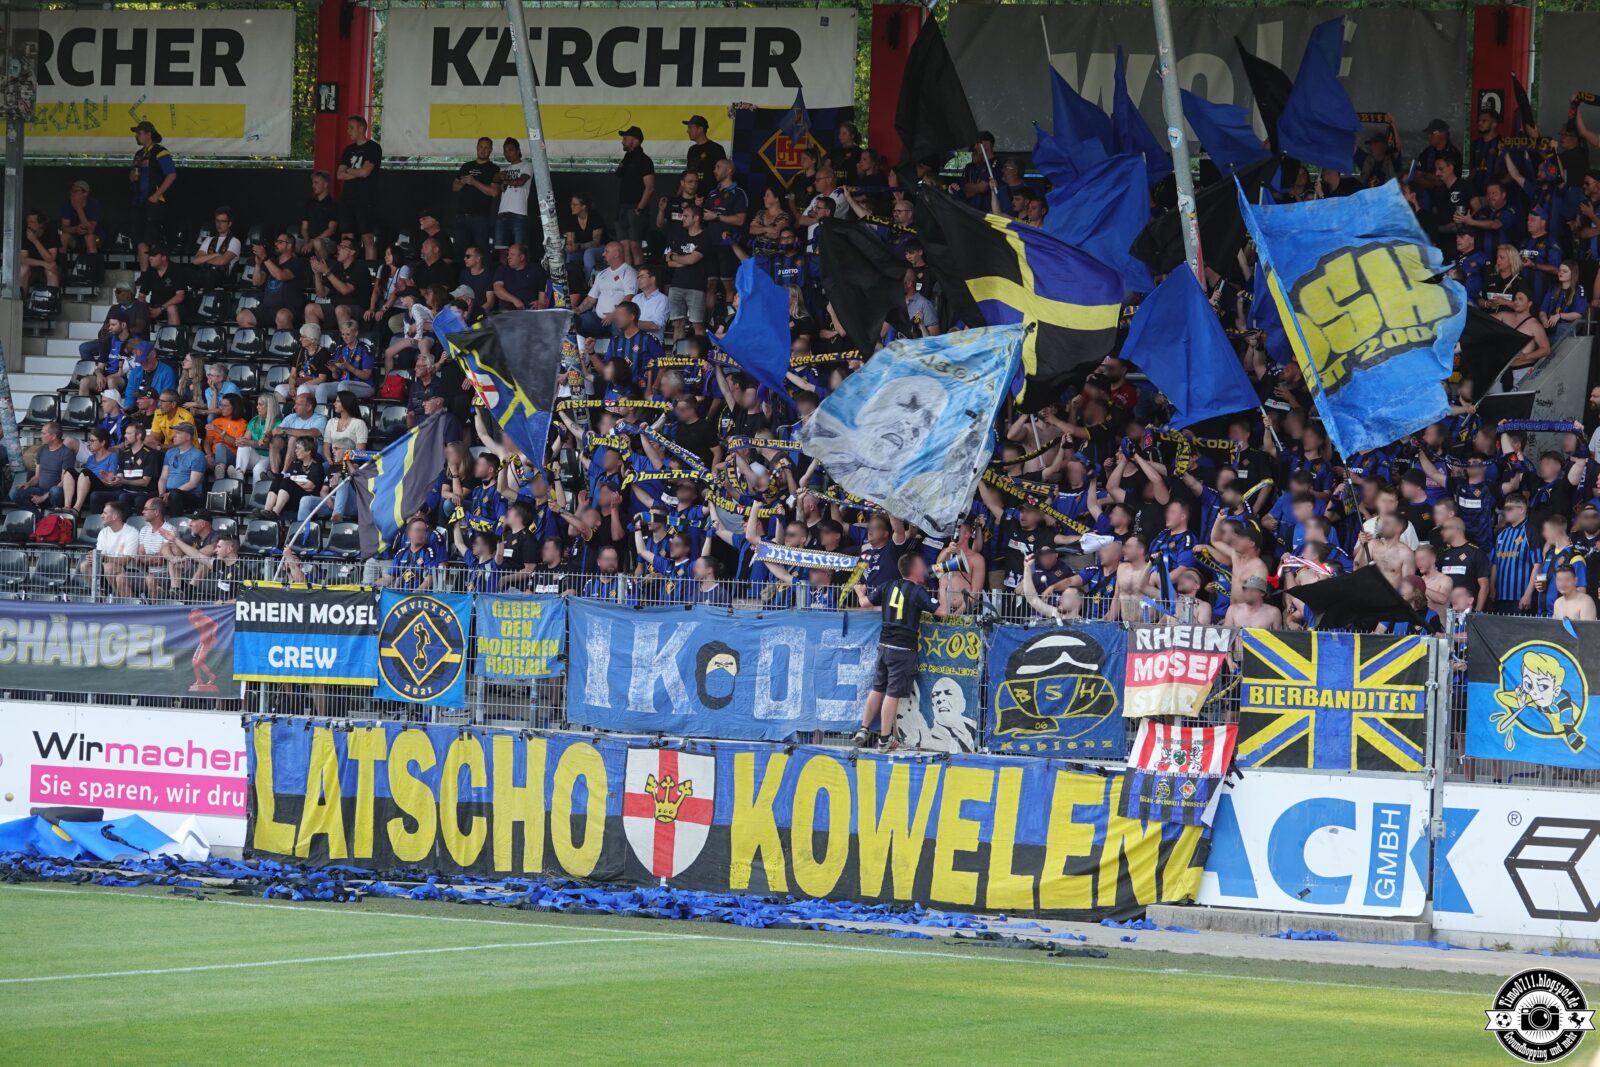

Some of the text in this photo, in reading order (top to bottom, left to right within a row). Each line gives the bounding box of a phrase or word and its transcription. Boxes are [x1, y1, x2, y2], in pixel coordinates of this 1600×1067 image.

[430, 26, 803, 89] KÄRCHER
[235, 599, 378, 626] RHEIN MOSEL
[394, 600, 453, 624] INVICTUS
[491, 600, 541, 619] GEGEN
[889, 586, 905, 620] 4
[501, 619, 533, 638] DEN
[1135, 625, 1232, 652] RHEIN
[267, 645, 338, 670] CREW
[478, 636, 559, 657] MODERNEN
[1248, 685, 1417, 713] BIERBANDITEN
[39, 773, 245, 808] Sie sparen, wir dru
[253, 721, 608, 879] LATSCHO
[1374, 808, 1402, 900] GMBH
